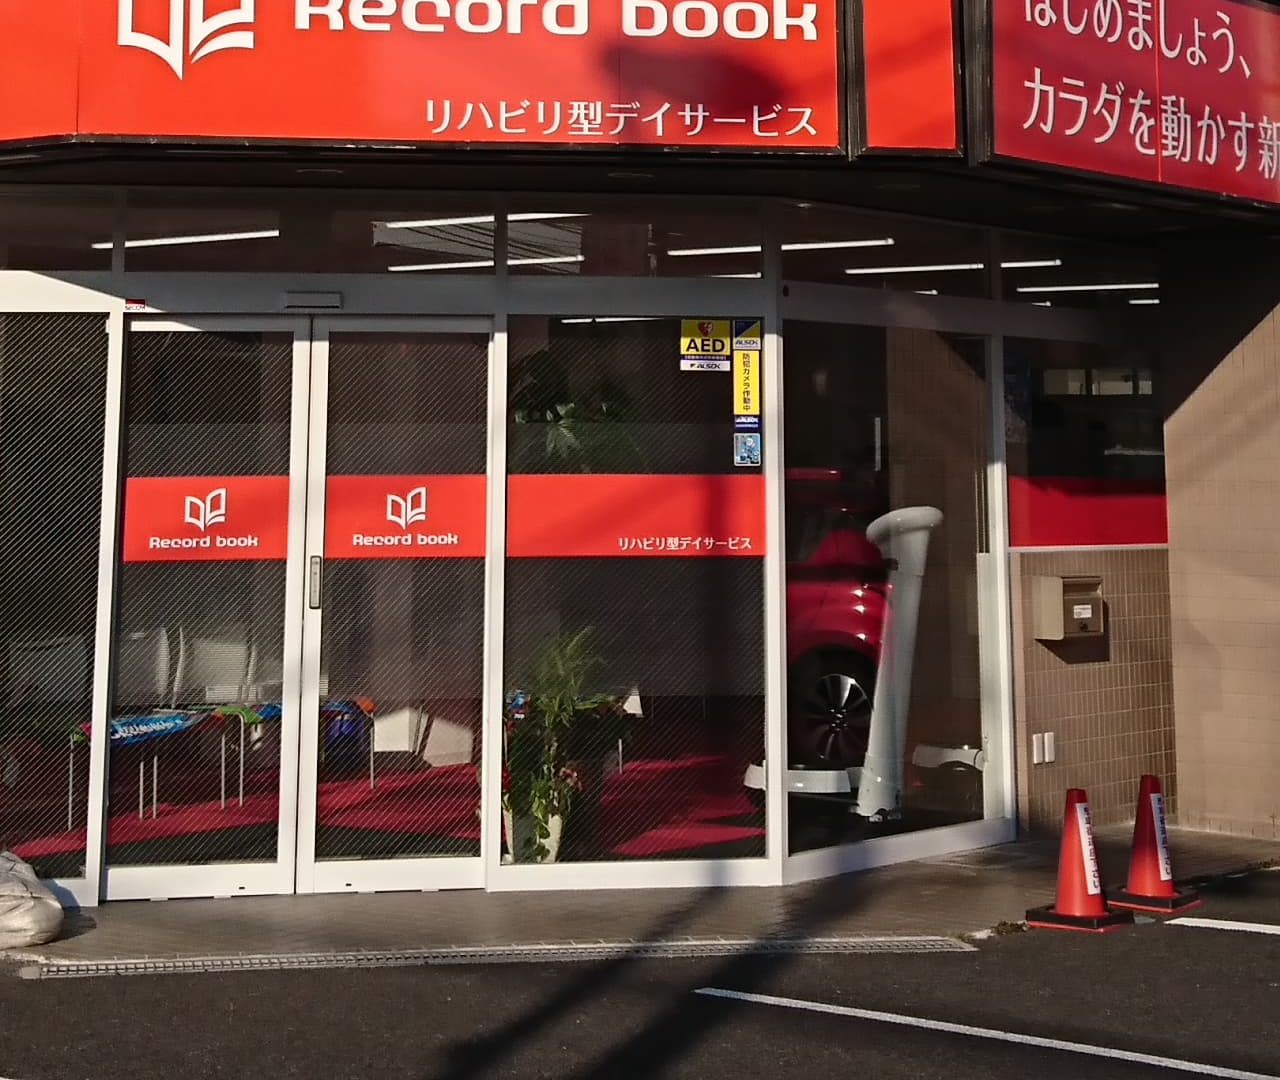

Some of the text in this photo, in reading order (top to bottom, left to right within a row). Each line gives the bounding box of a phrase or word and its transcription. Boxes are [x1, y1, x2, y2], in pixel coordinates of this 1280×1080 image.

[424, 98, 818, 137] リハビリ型デイサービス
[686, 338, 725, 353] AED
[149, 534, 258, 549] Record book
[353, 532, 458, 546] Record book
[619, 536, 752, 550] リハビリ型デイサービス
